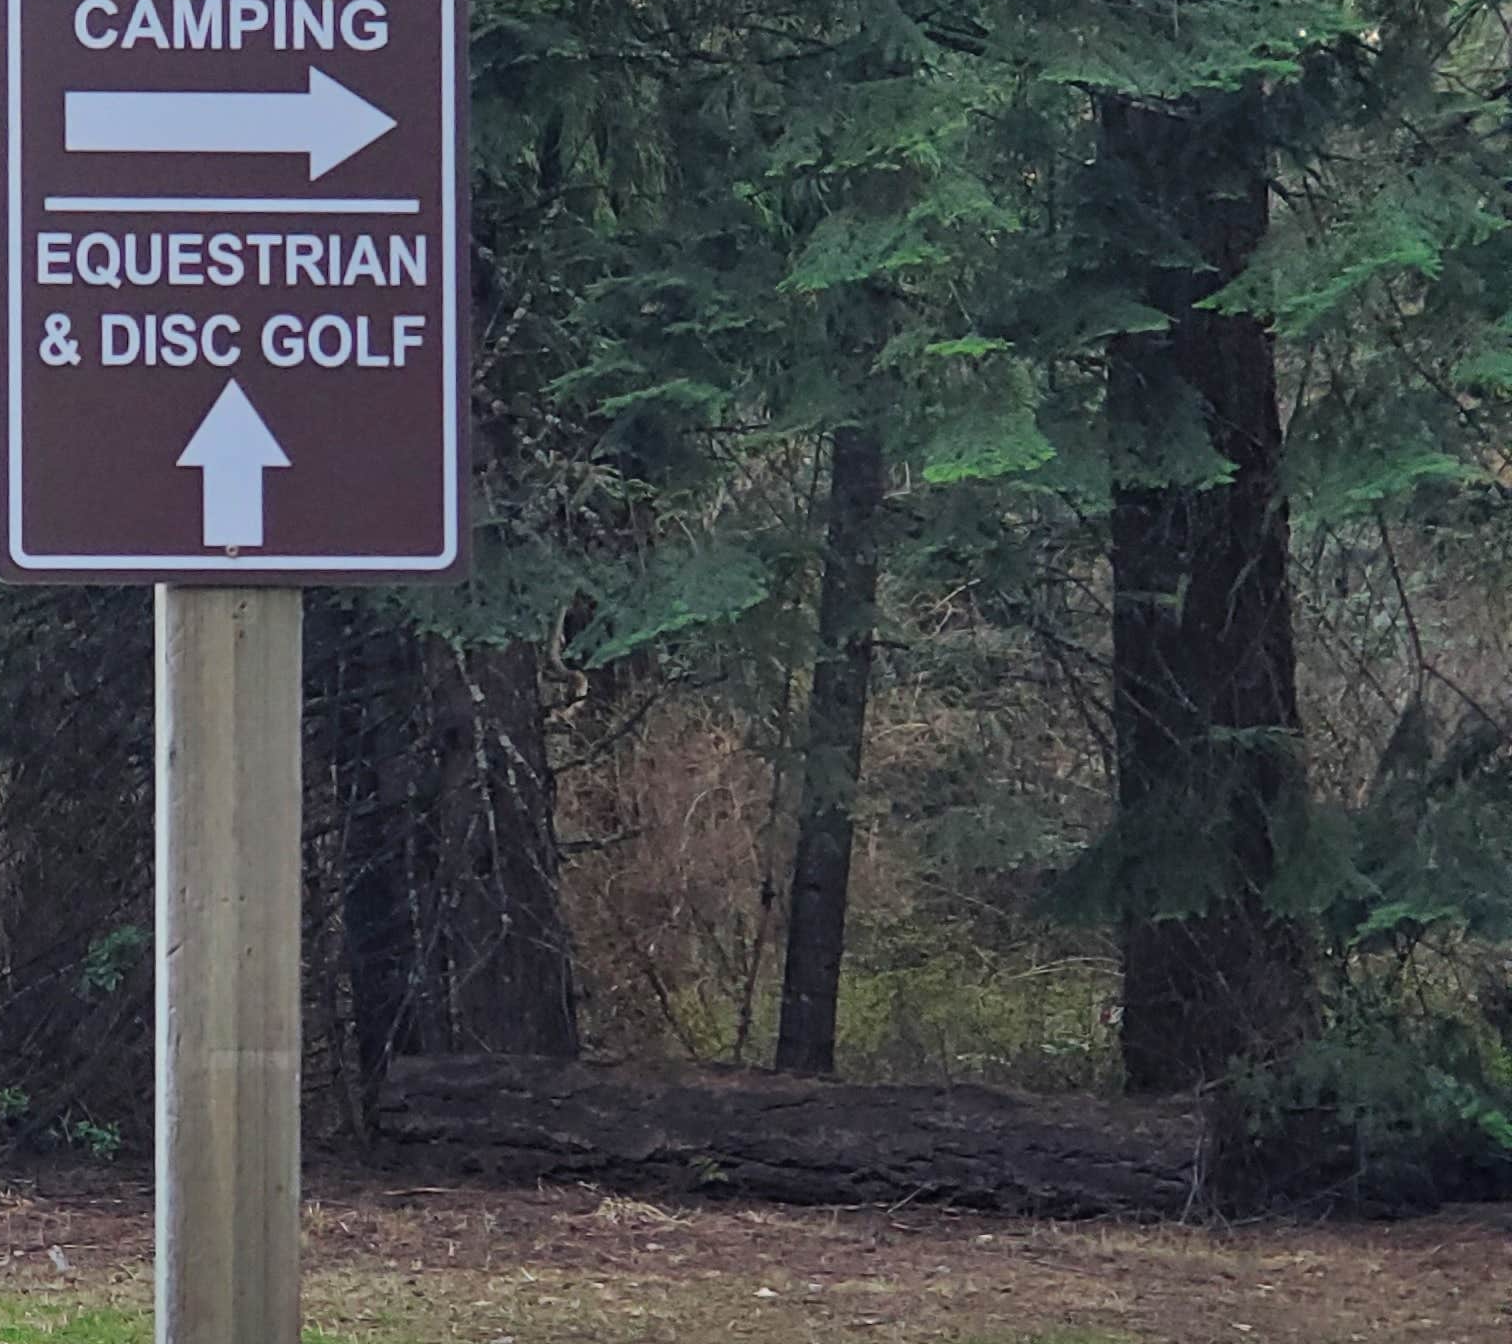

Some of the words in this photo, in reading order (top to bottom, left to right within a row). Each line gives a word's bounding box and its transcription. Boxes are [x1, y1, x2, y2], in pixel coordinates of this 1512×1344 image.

[38, 233, 426, 288] EQUESTRIAN
[40, 314, 81, 365] &
[102, 314, 240, 366] DISC
[262, 315, 425, 366] GOLF
